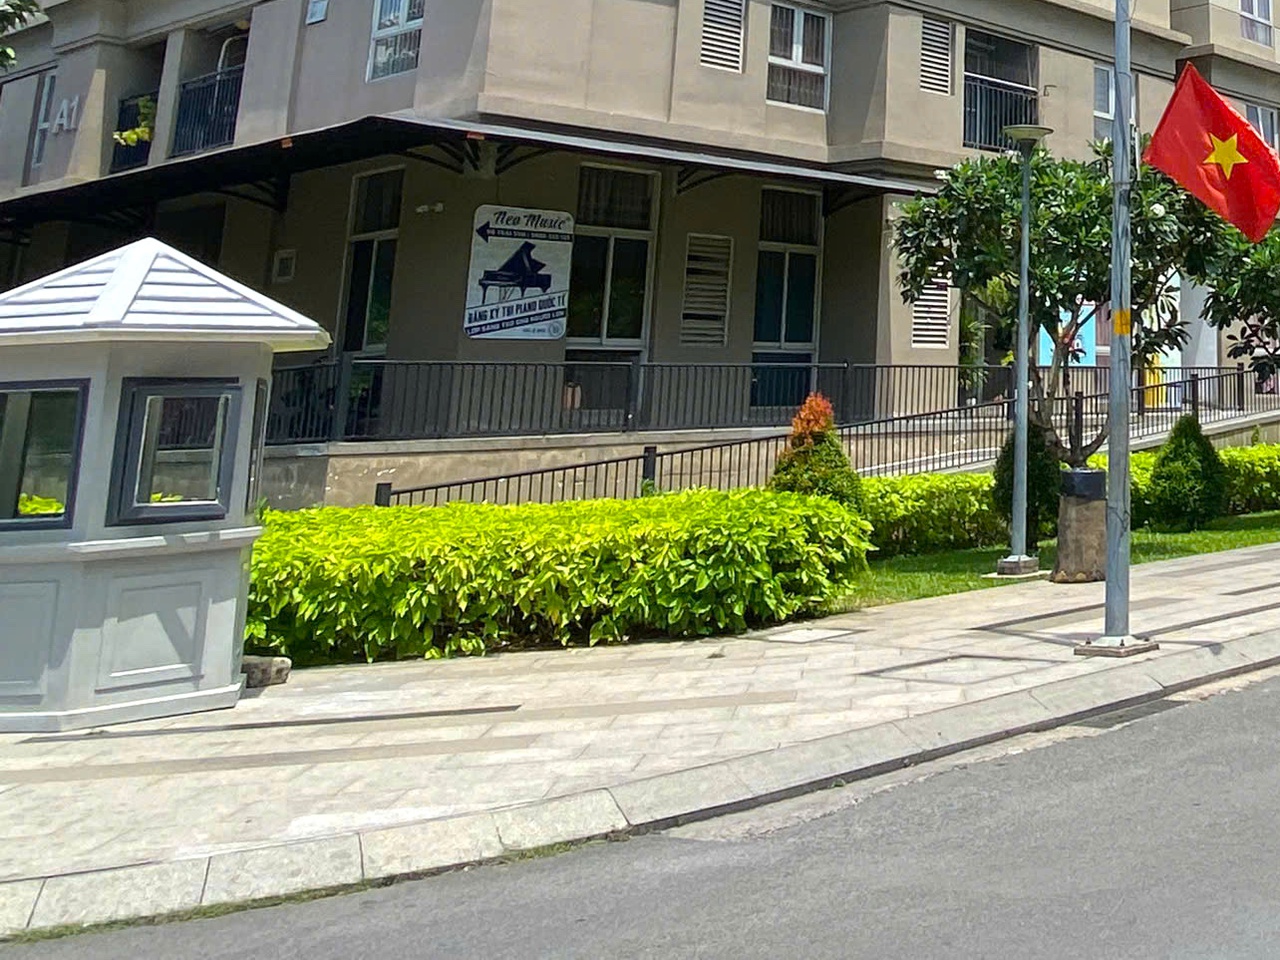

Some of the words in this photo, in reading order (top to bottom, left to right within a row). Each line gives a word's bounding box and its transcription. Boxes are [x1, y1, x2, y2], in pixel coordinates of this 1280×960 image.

[493, 211, 520, 226] Neo
[524, 213, 566, 230] Music
[516, 300, 537, 315] PIANO
